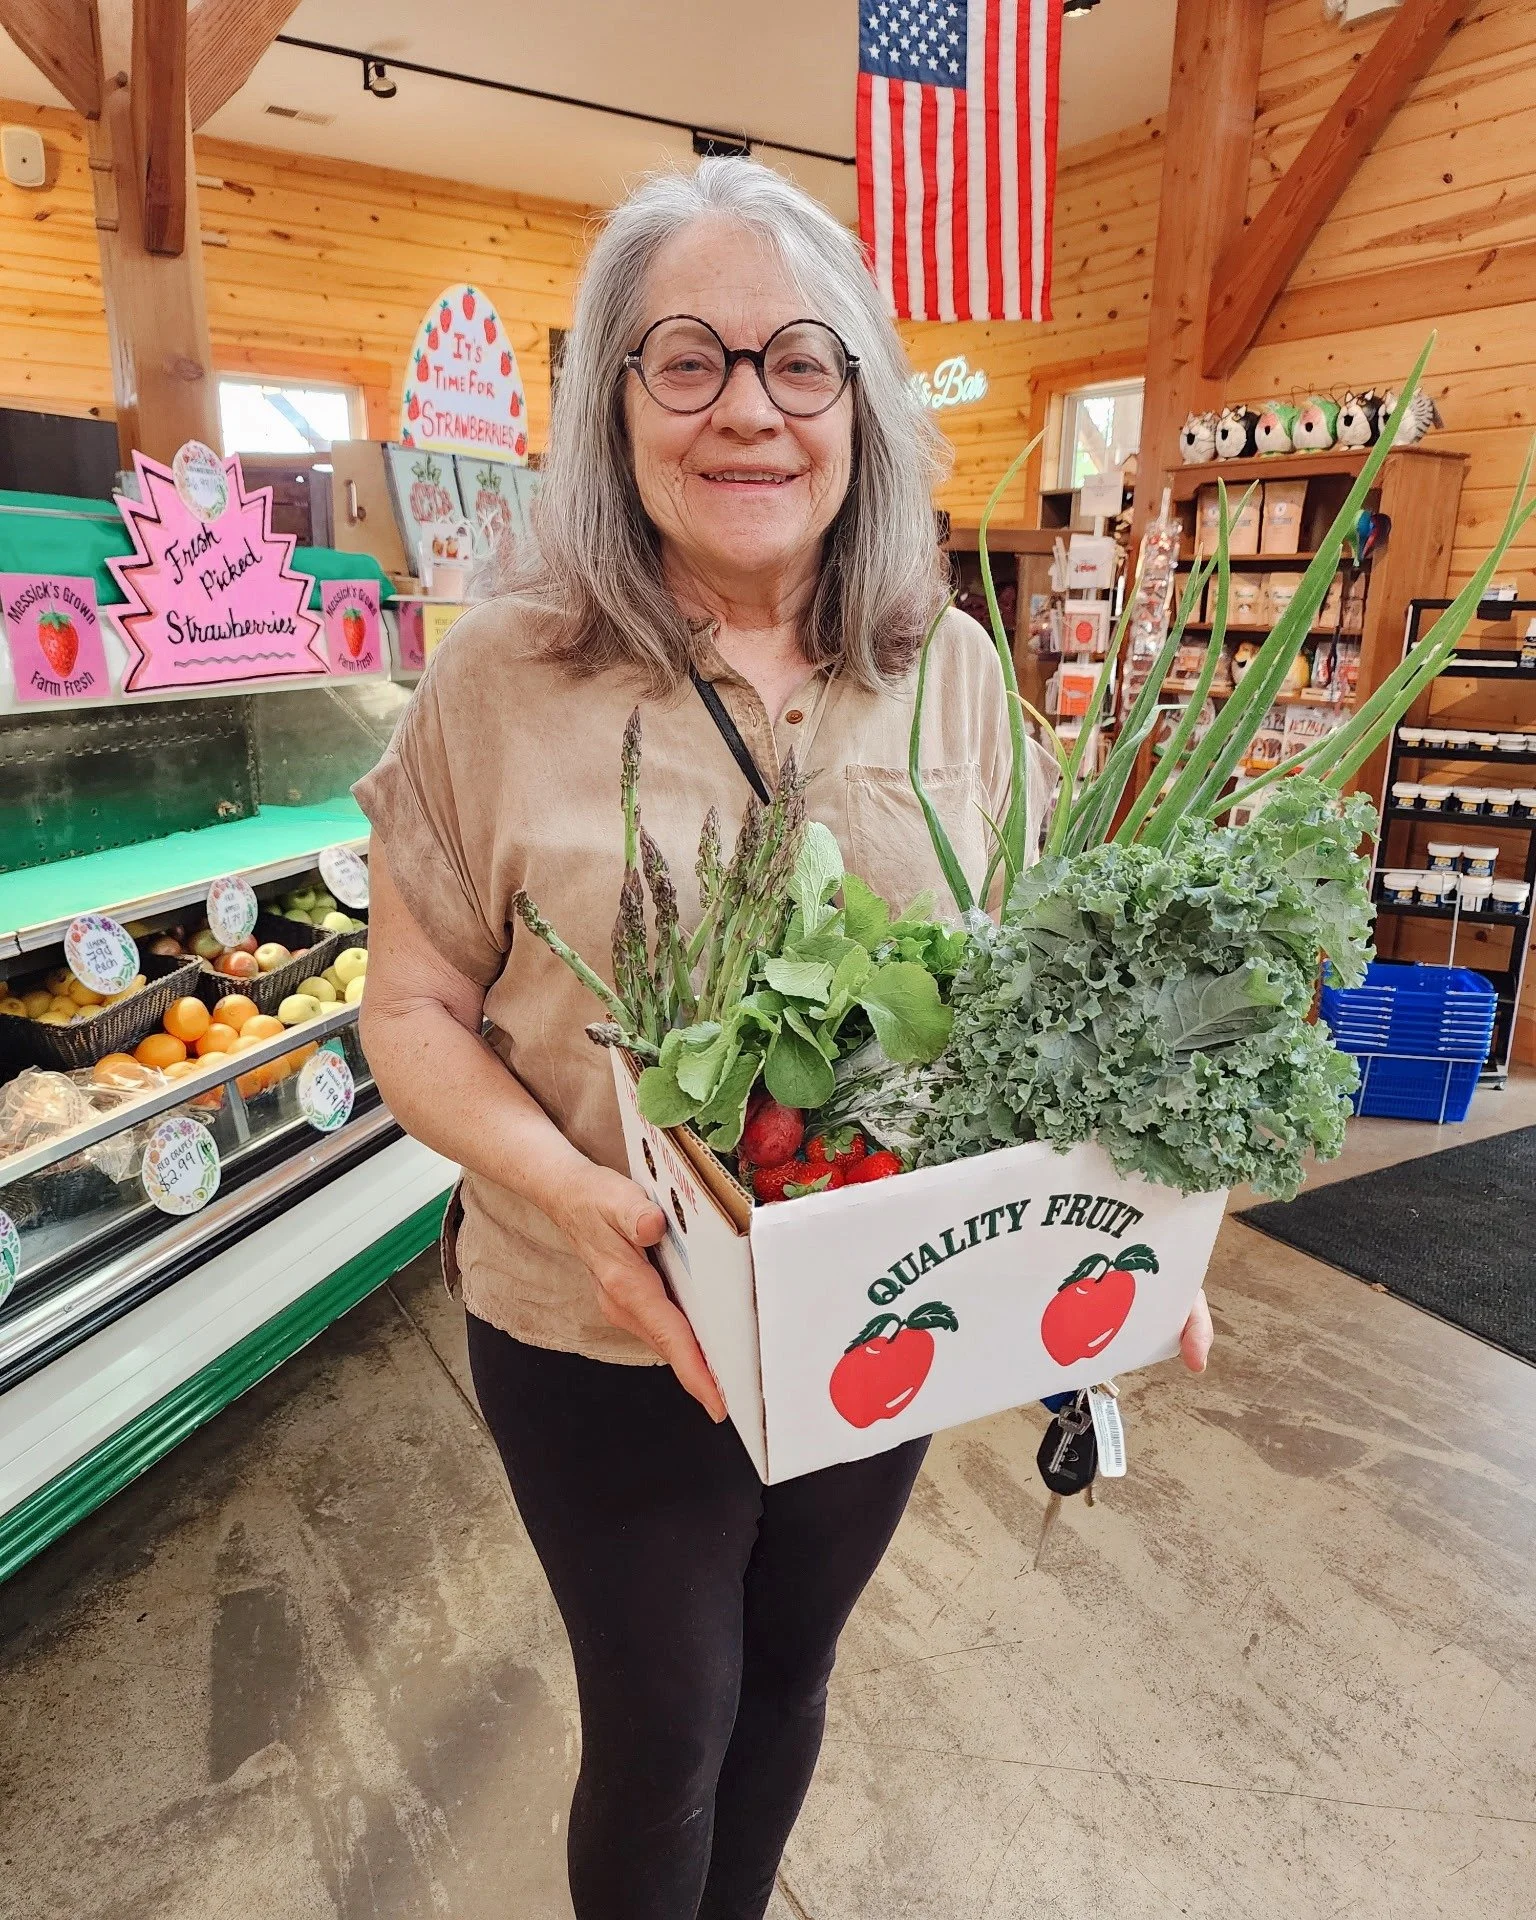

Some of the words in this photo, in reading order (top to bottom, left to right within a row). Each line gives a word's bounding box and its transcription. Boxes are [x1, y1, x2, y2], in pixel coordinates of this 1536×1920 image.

[931, 354, 988, 409] Bar
[421, 400, 515, 449] STRAWBERRIES
[165, 522, 222, 585] Fresh
[199, 537, 263, 601] Picked
[7, 581, 60, 625] Messick's
[62, 587, 96, 625] Grown
[166, 607, 297, 645] Strawberries
[30, 670, 61, 697] Farm
[64, 670, 95, 697] Fresh
[867, 1198, 1032, 1306] QUALITY
[1040, 1193, 1144, 1240] FRUIT
